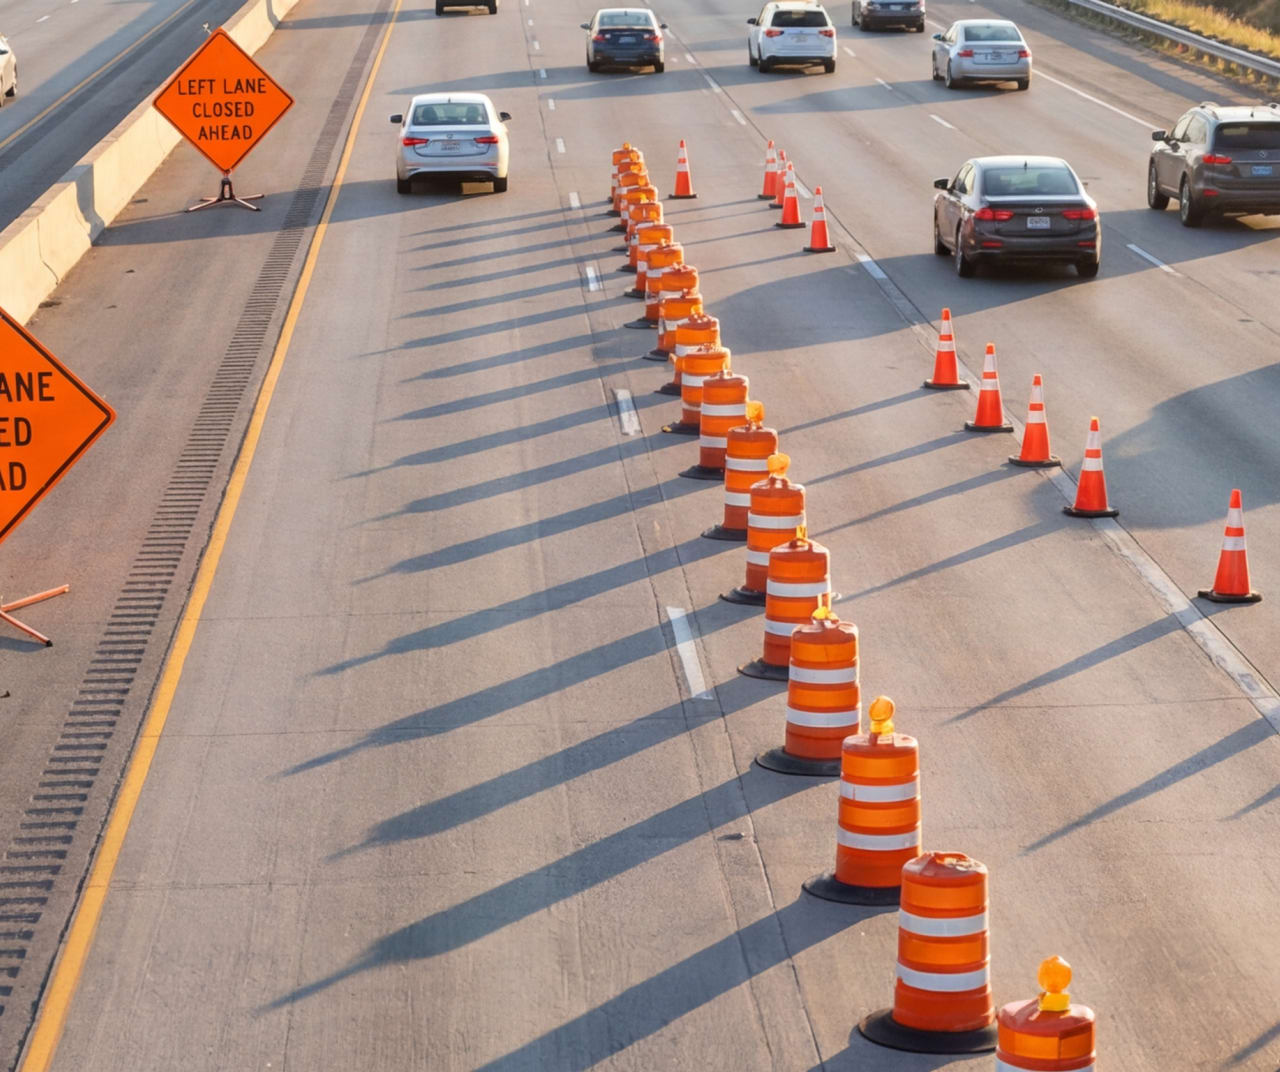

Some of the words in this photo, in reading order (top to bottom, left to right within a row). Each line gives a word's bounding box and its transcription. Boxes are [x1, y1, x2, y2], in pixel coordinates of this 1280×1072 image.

[177, 79, 216, 95] LEFT
[223, 78, 266, 94] LANE
[192, 101, 254, 118] CLOSED
[198, 125, 252, 140] AHEAD
